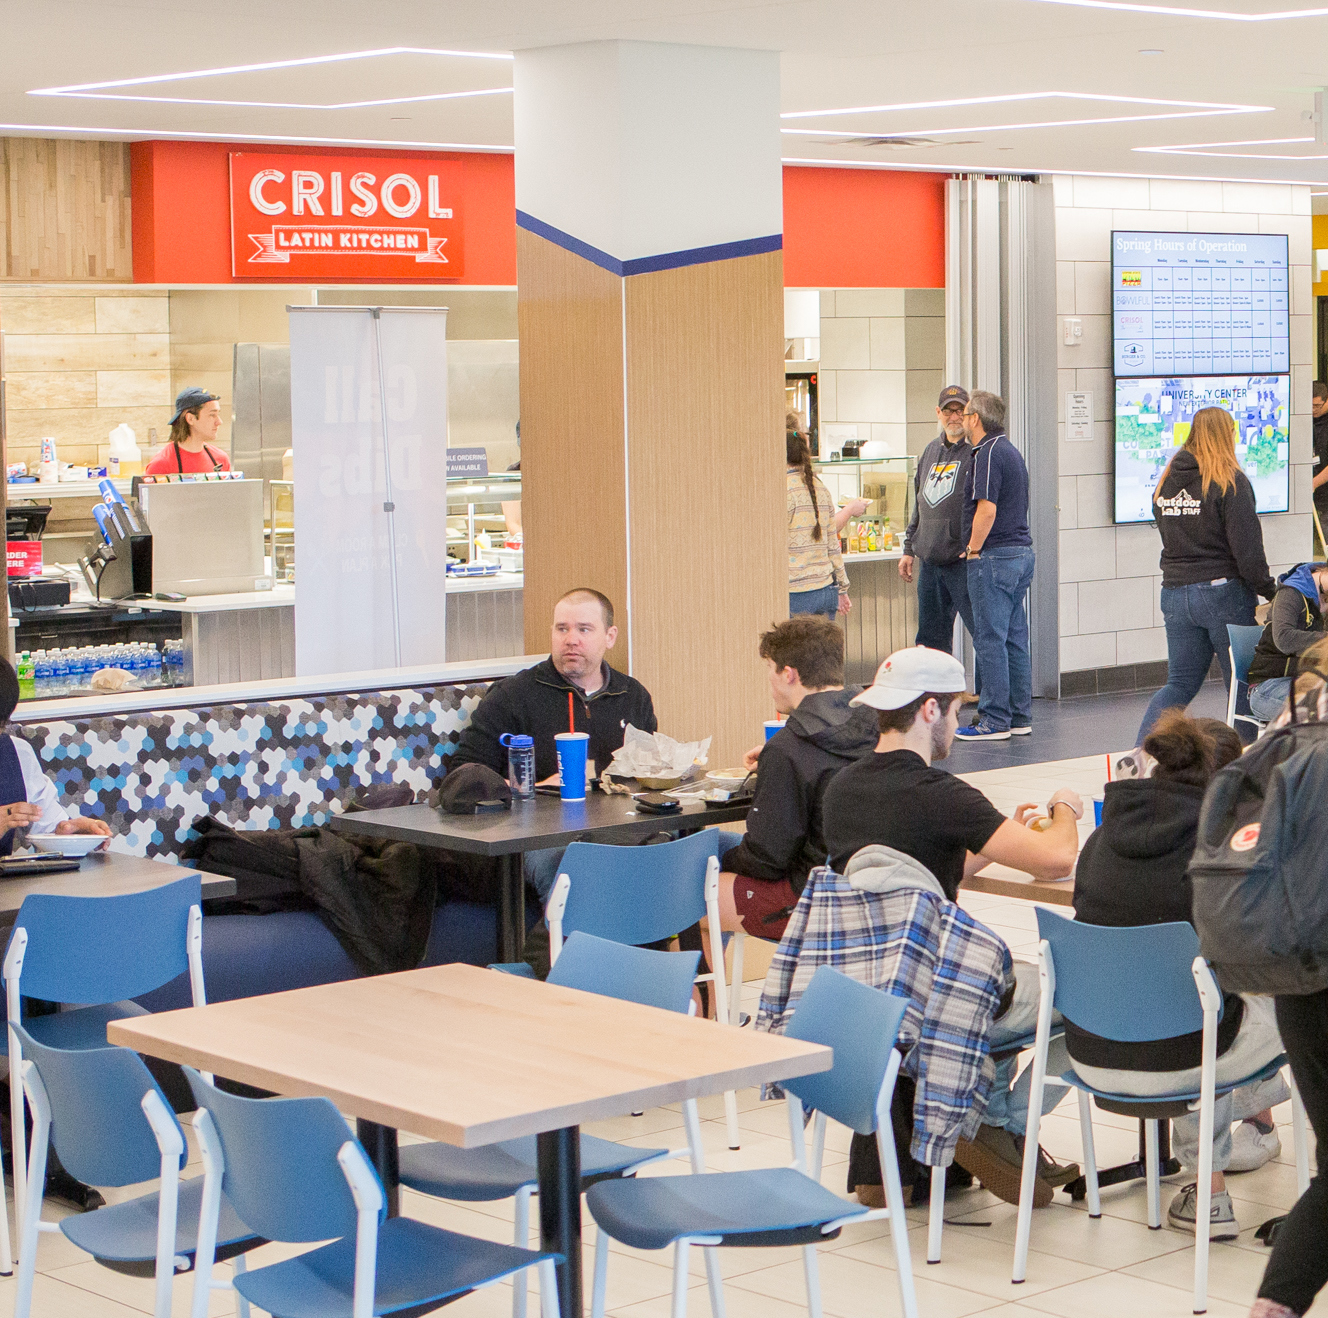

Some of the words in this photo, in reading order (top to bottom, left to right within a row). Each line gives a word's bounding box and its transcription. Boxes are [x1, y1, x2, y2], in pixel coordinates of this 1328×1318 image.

[249, 169, 453, 218] CRISOL
[278, 231, 333, 247] LATIN
[339, 232, 419, 248] KITCHEN
[1116, 238, 1151, 253] Spring
[1154, 239, 1185, 251] Hours
[1187, 239, 1198, 251] of
[1199, 240, 1248, 255] Operation
[1214, 388, 1248, 398] CENTER
[457, 453, 487, 461] ORDERING
[450, 463, 481, 471] AVAILABLE
[1156, 496, 1201, 508] Outdoor
[1161, 506, 1182, 516] Lab
[1182, 507, 1201, 515] STAFF
[7, 551, 28, 559] RDER
